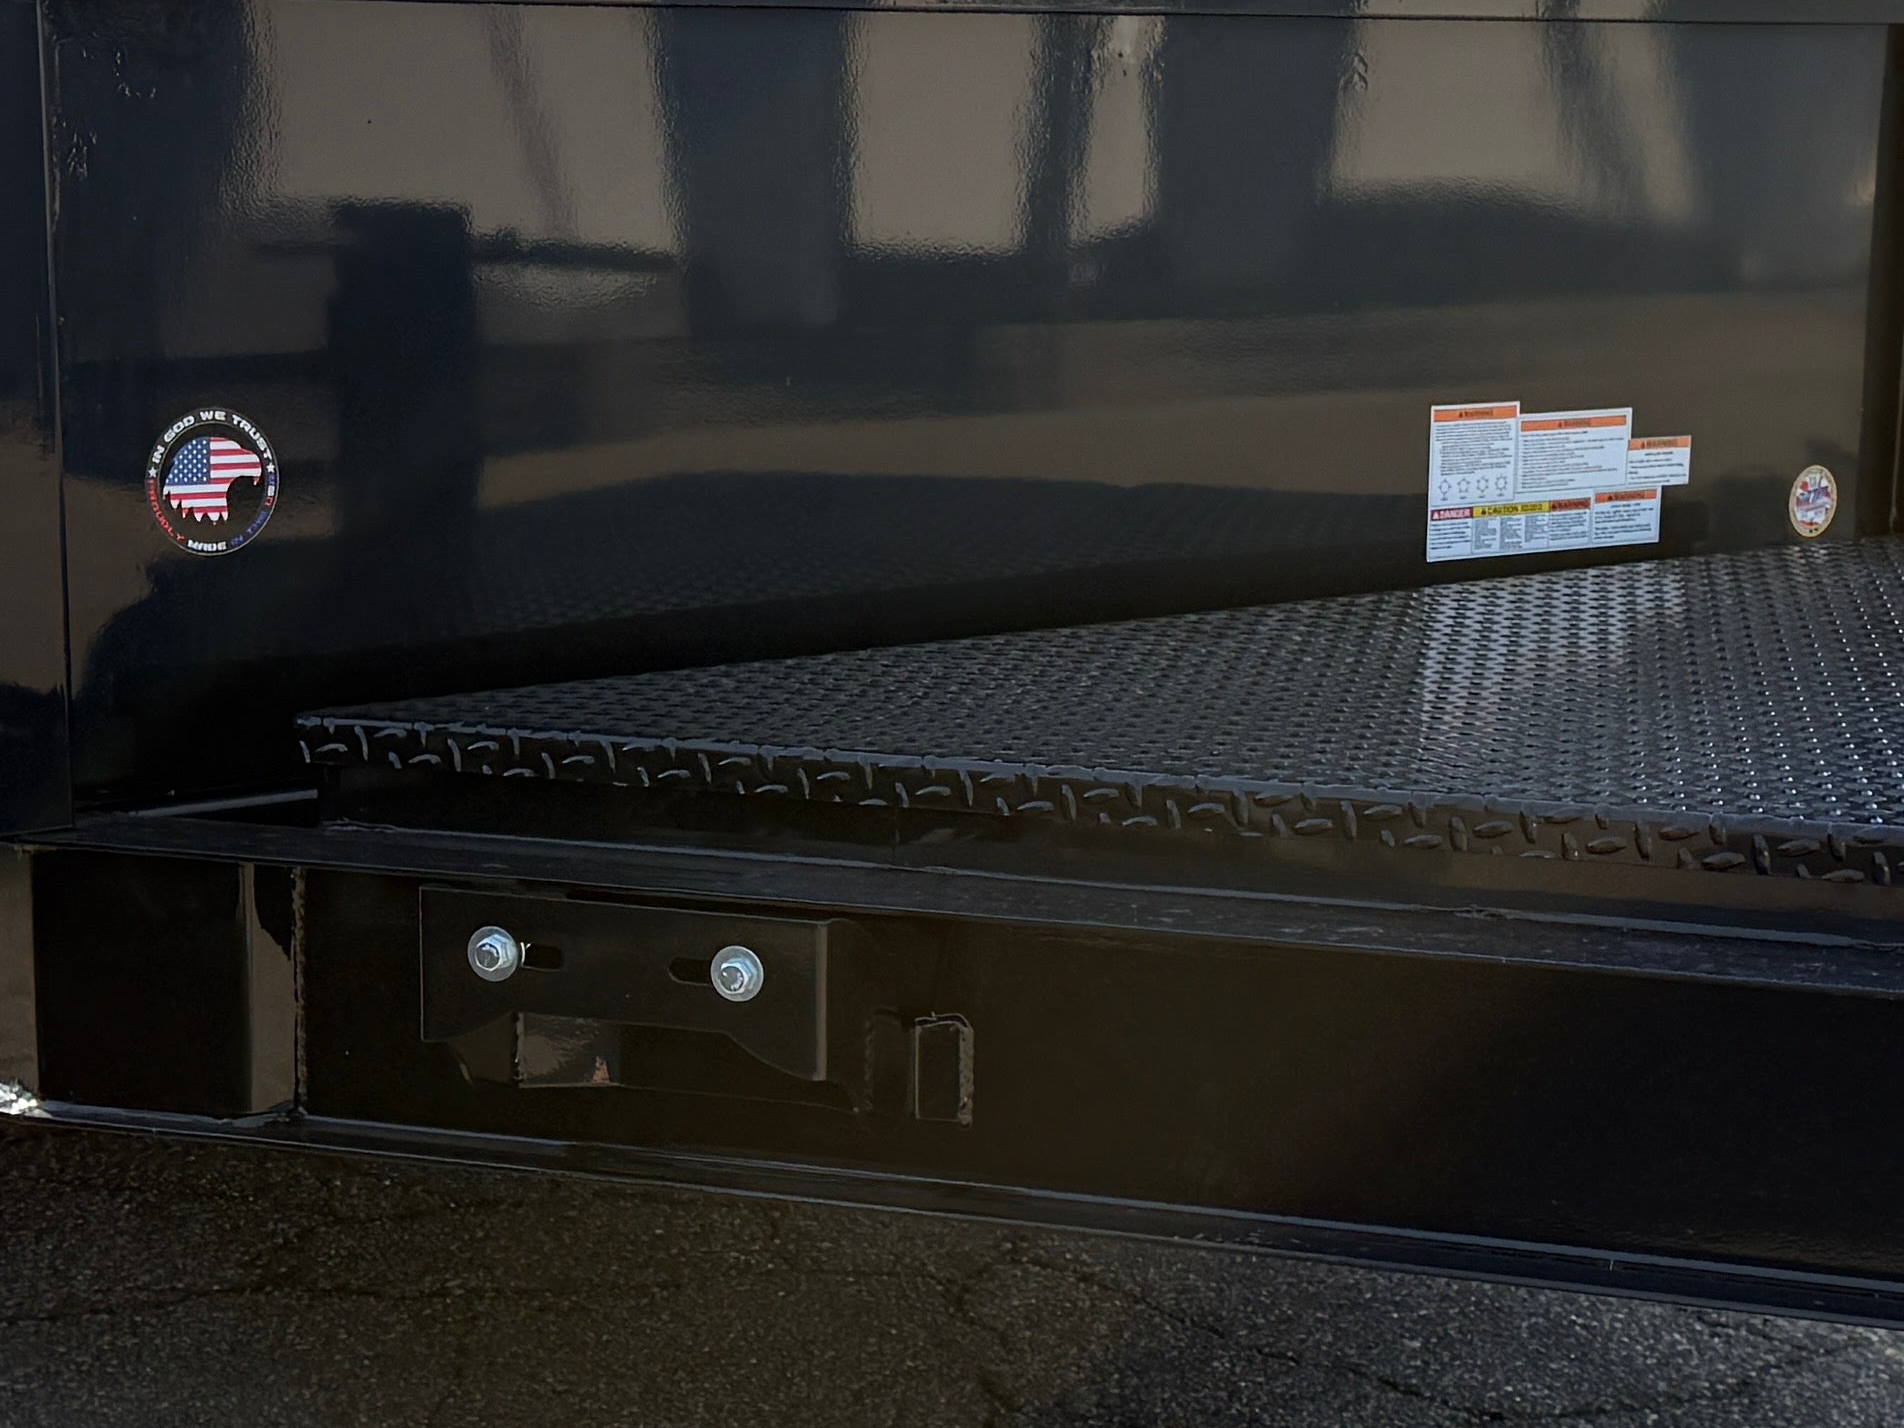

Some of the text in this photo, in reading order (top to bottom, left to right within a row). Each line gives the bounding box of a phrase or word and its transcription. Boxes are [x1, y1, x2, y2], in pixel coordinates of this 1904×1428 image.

[152, 410, 273, 464] IN GOD WE TRUST
[187, 538, 227, 552] MADE
